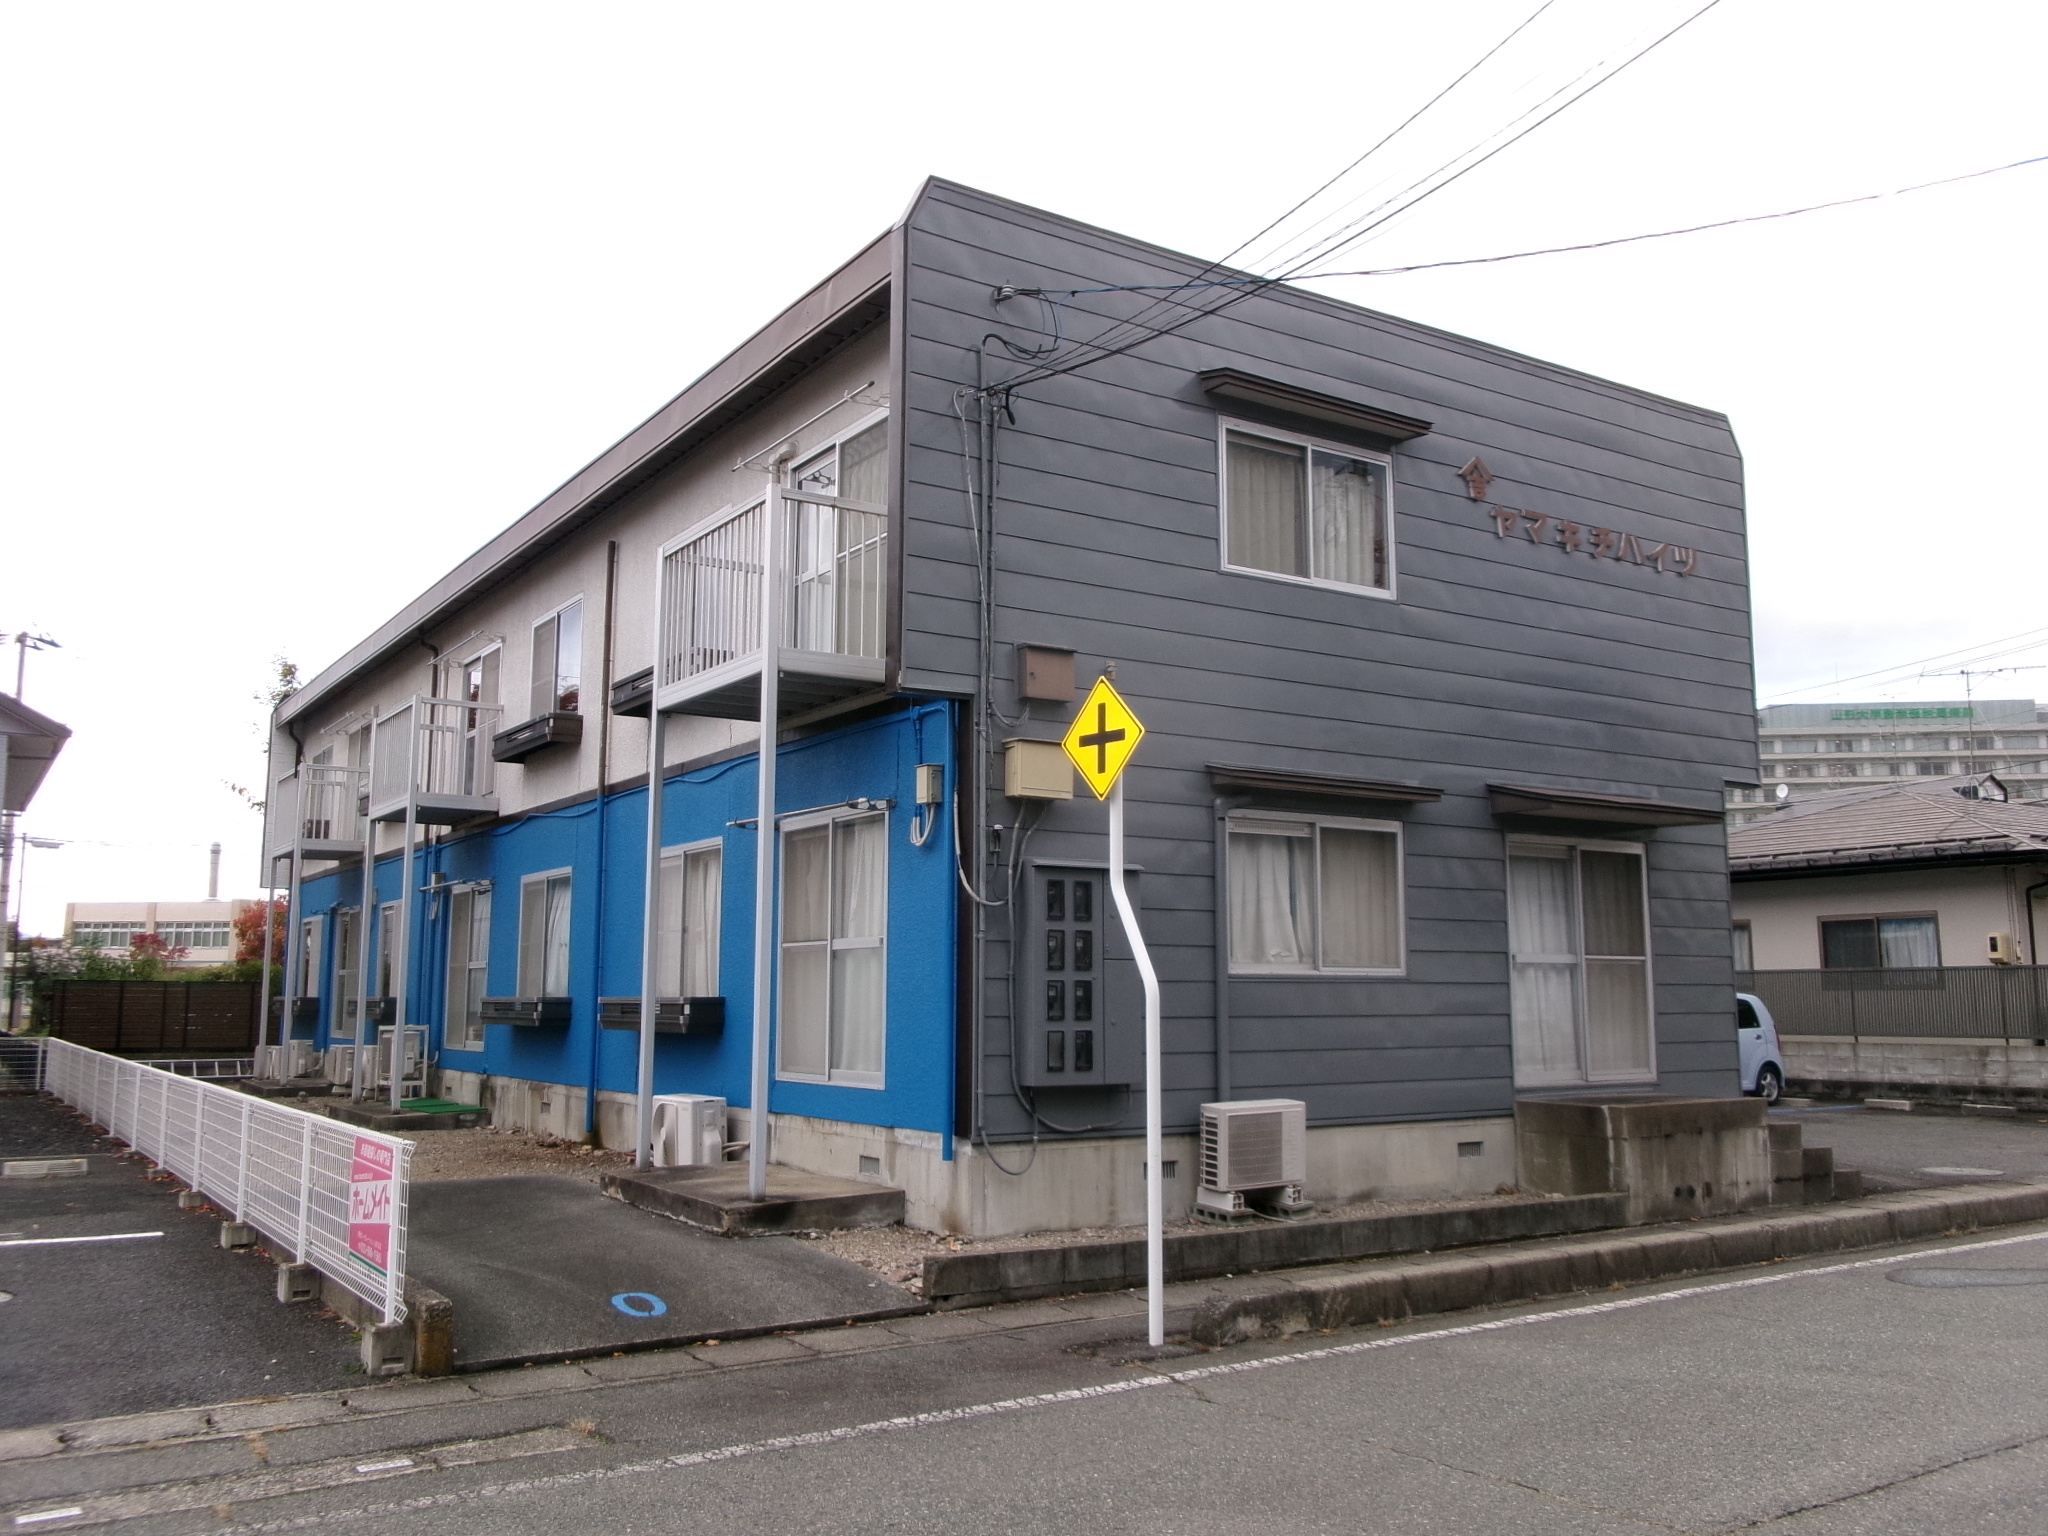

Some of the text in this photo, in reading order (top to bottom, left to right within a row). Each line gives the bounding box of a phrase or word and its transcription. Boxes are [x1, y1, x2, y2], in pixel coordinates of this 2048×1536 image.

[1490, 504, 1698, 577] ヤマキチハイツ
[351, 1184, 391, 1220] ホームメイト
